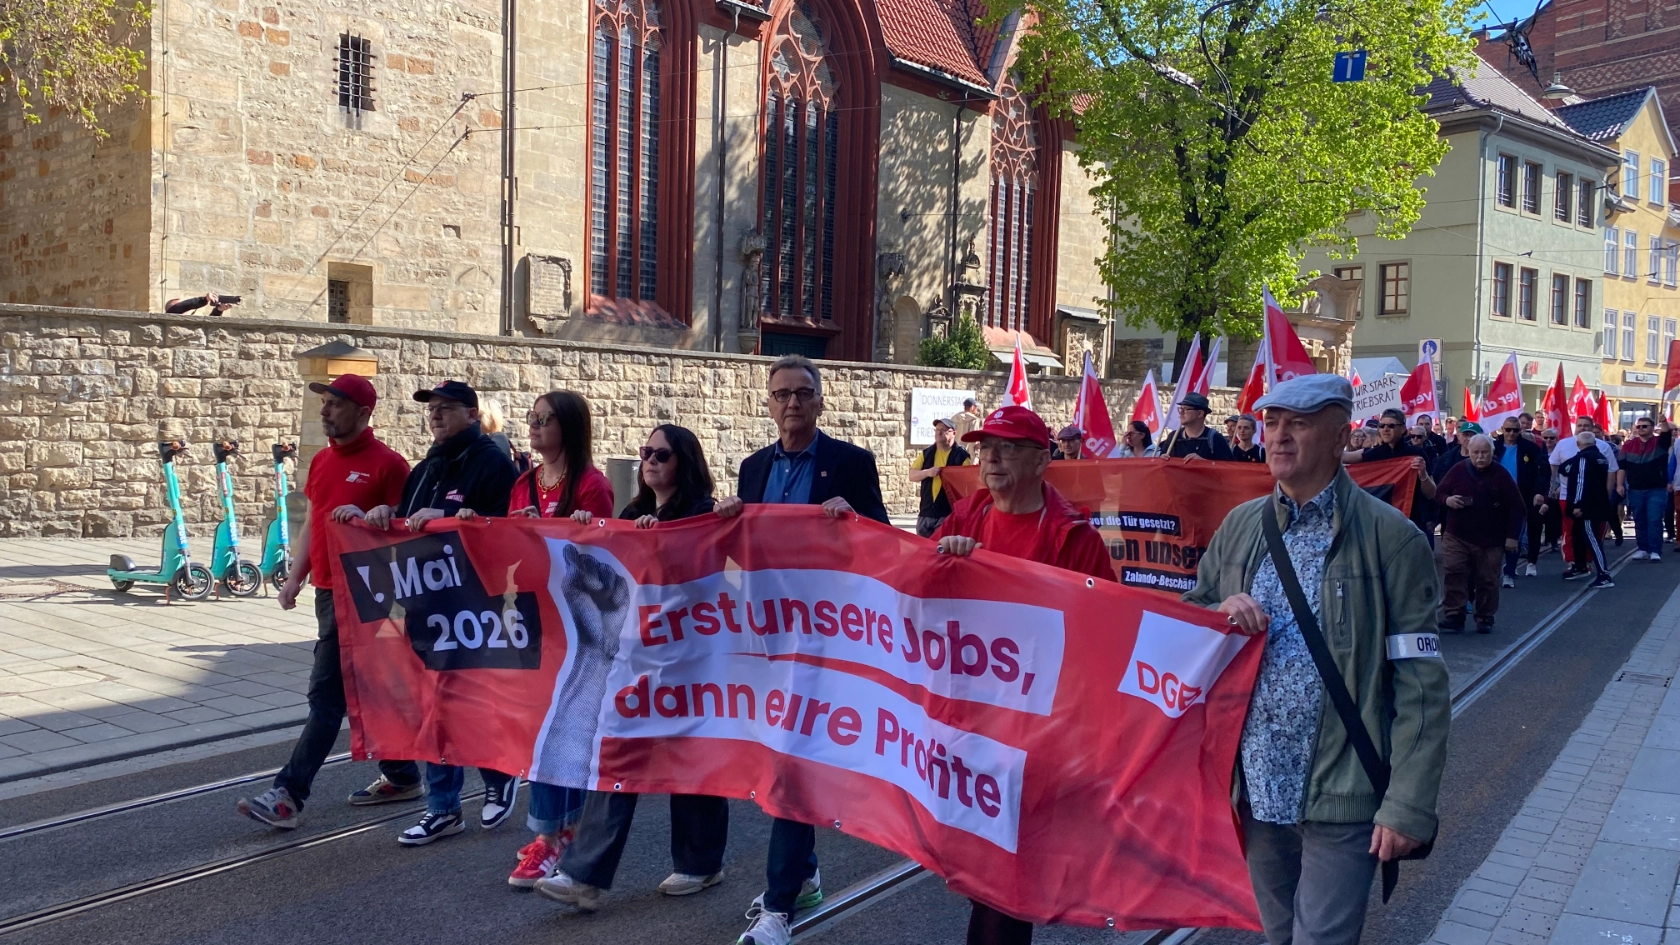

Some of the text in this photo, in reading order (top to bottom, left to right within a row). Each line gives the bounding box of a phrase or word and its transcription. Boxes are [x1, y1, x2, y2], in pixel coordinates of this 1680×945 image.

[1369, 376, 1397, 393] STARK
[1105, 515, 1121, 526] die
[1122, 515, 1138, 527] Tür
[389, 544, 463, 600] Mai
[426, 608, 530, 652] 2026
[638, 592, 1037, 696] Erst unsere Jobs,
[614, 674, 756, 721] dann
